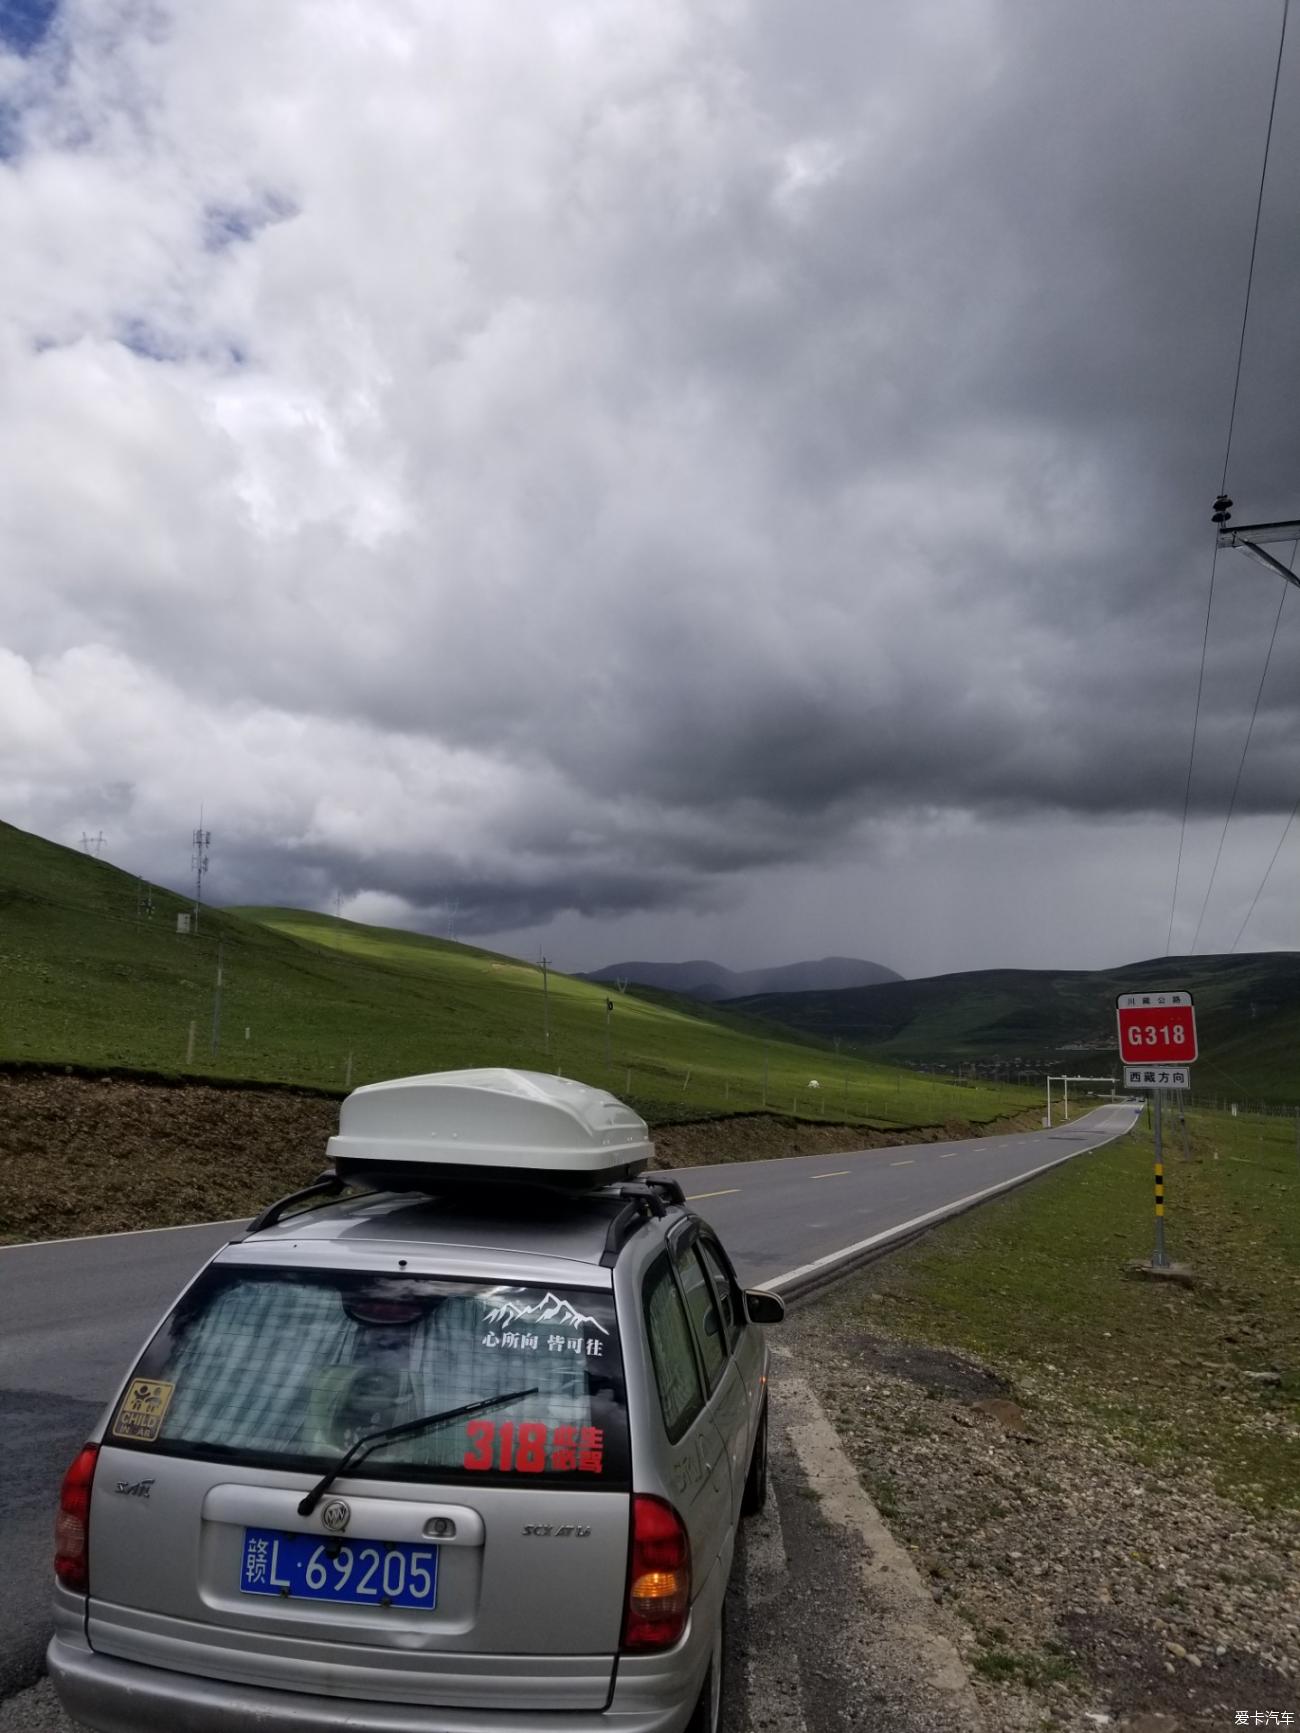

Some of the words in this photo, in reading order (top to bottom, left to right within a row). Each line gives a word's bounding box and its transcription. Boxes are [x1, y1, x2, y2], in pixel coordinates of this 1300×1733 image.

[1128, 1025, 1185, 1045] G318
[1129, 1071, 1185, 1083] 西藏方向
[482, 1331, 539, 1350] 心所向
[547, 1334, 603, 1356] 皆可往
[121, 1412, 157, 1428] CHILD
[119, 1425, 131, 1434] IN
[463, 1420, 548, 1473] 318
